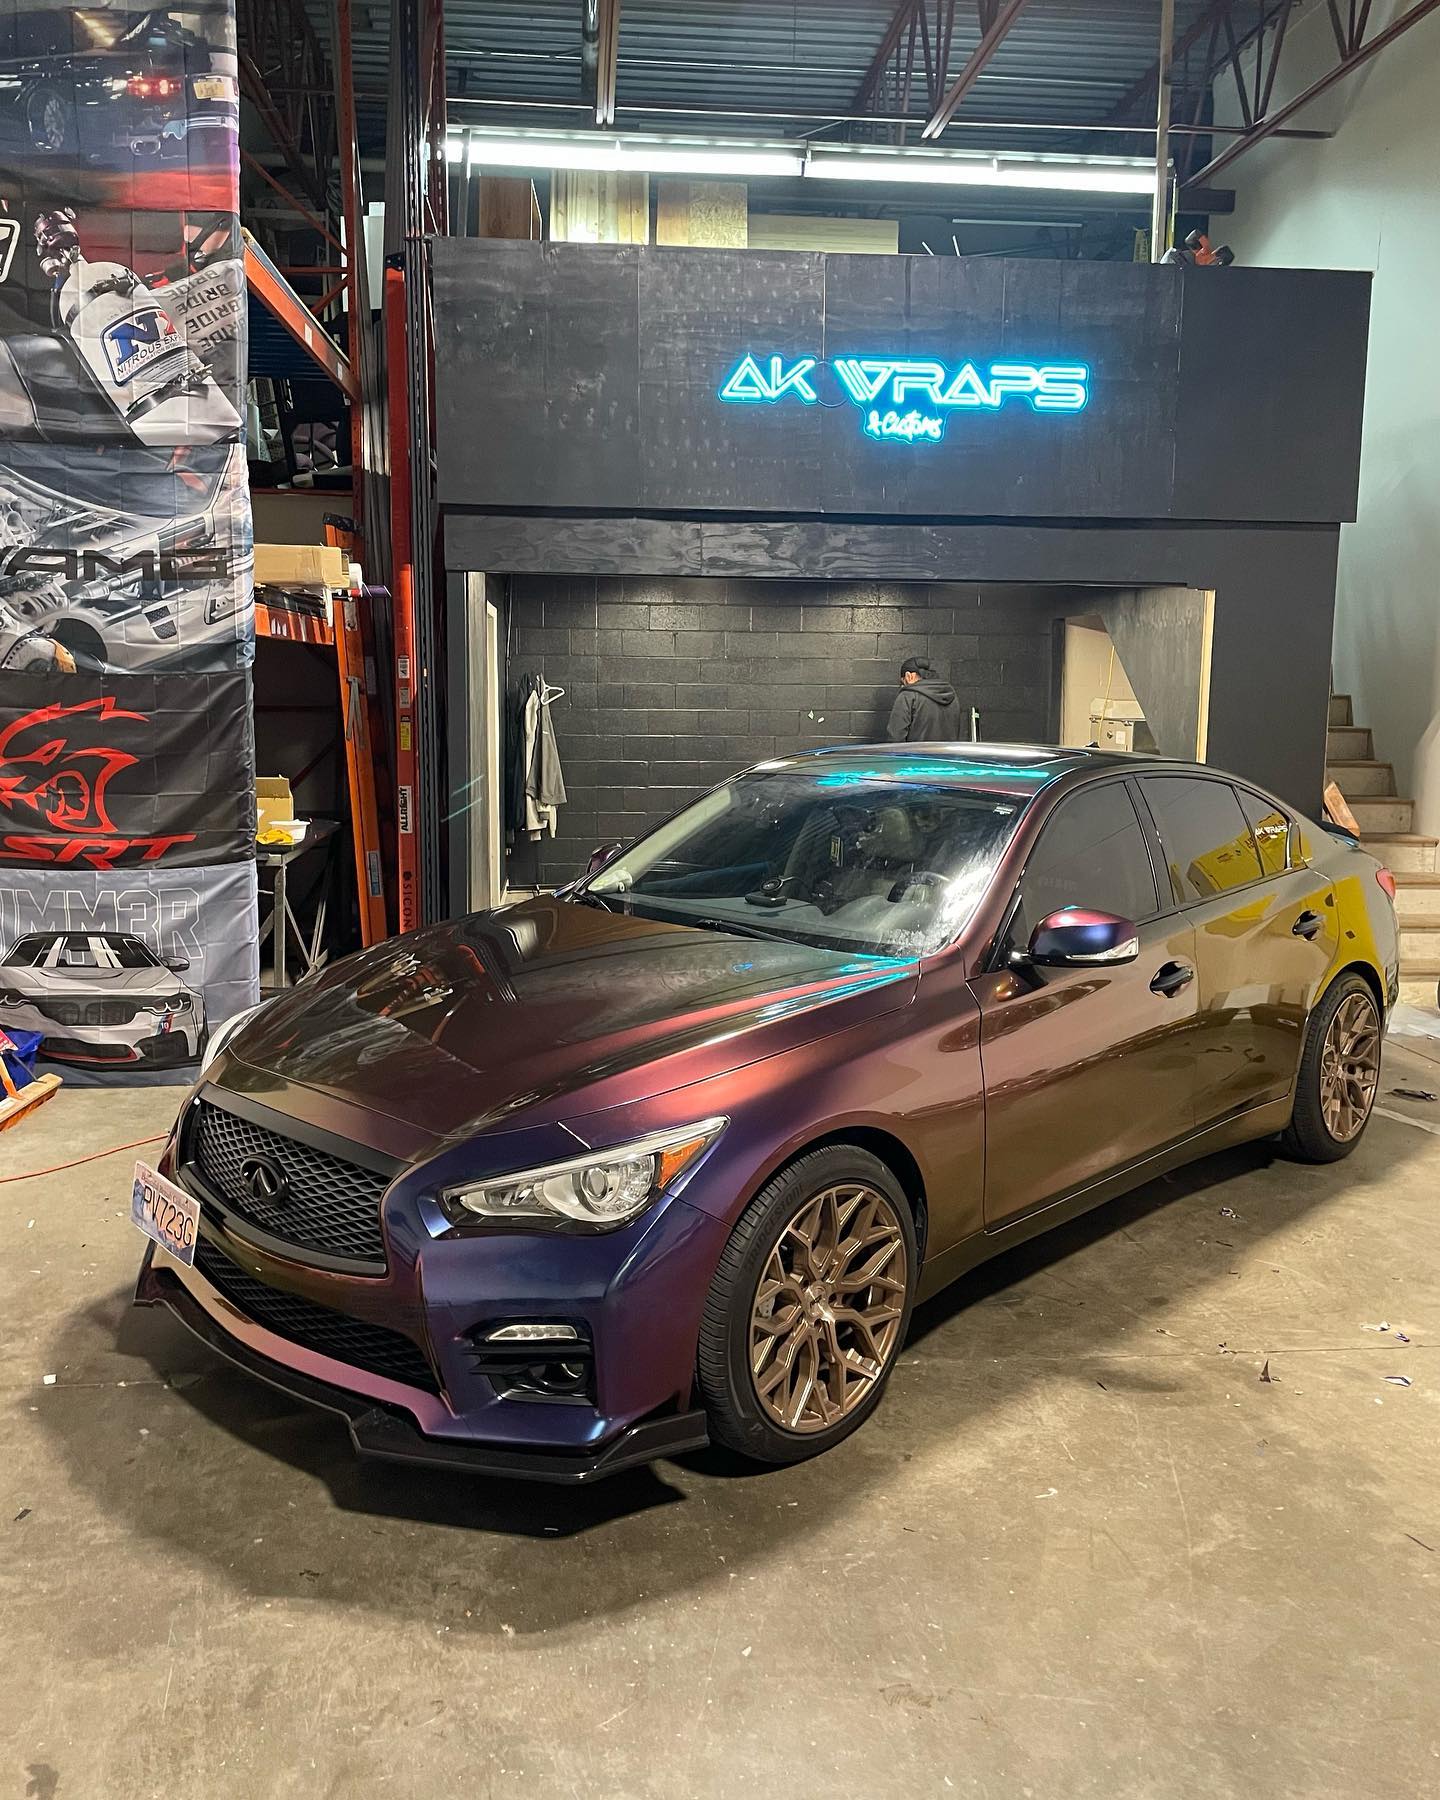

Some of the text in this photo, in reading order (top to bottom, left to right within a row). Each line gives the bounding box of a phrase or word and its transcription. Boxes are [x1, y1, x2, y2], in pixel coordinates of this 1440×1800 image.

[163, 270, 220, 301] BRIDE
[175, 283, 232, 316] BRIDE
[185, 299, 240, 334] BRIDE
[116, 340, 162, 375] NITROUS
[721, 354, 1087, 409] AK WRAPS
[4, 547, 228, 581] AMG
[400, 787, 409, 832] ALLRIGHT
[0, 834, 197, 871] SRT
[144, 1185, 194, 1246] PV723G
